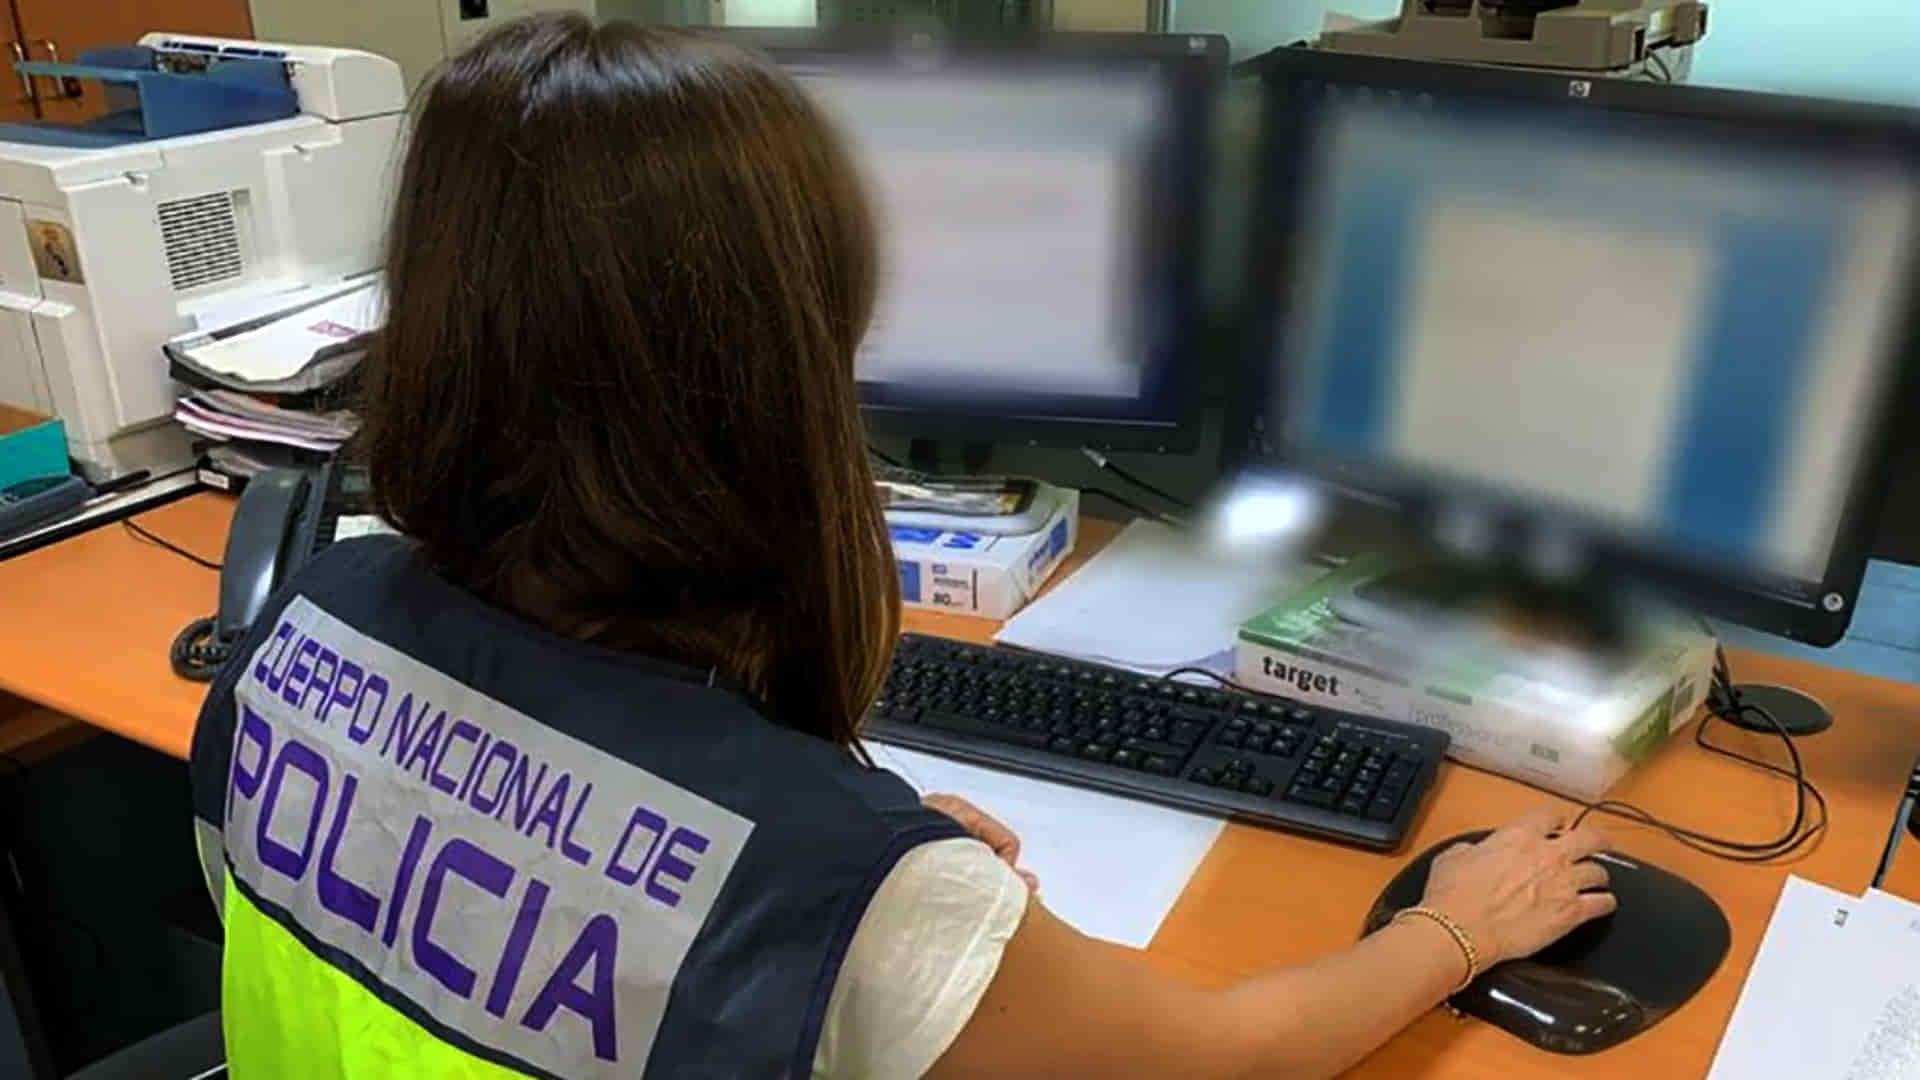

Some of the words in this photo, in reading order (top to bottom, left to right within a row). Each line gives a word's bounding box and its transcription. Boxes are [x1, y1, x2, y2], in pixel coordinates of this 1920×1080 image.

[254, 621, 389, 746] CUERPO
[380, 692, 593, 867] NACIONAL
[604, 806, 710, 908] DE
[1262, 655, 1339, 697] target
[228, 704, 618, 1063] POLICIA
